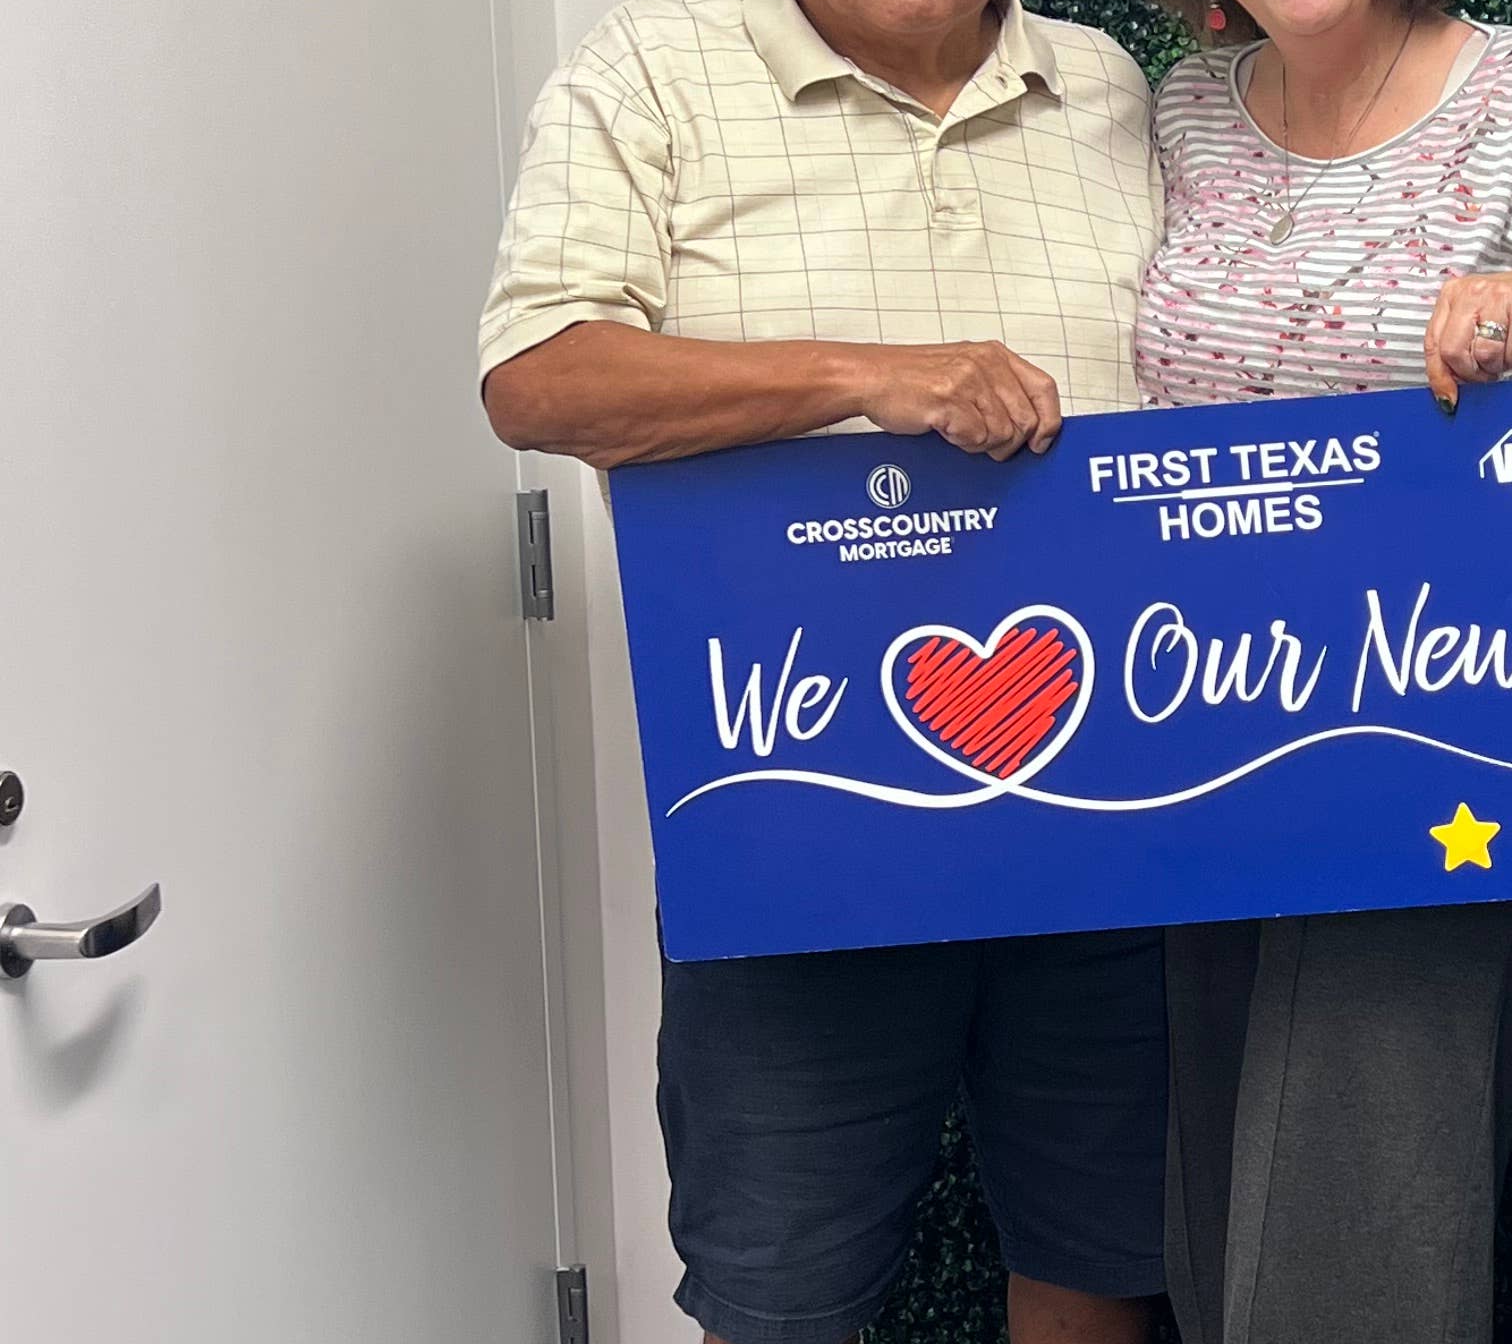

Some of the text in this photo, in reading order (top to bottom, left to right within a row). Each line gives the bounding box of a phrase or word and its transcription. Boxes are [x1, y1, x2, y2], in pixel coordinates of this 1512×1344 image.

[1089, 434, 1381, 493] FIRST TEXAS
[786, 507, 998, 545] CROSSCOUNTRY
[1159, 494, 1323, 541] HOMES
[839, 536, 952, 562] MORTGAGE
[708, 626, 849, 757] We
[1124, 601, 1327, 723] Our
